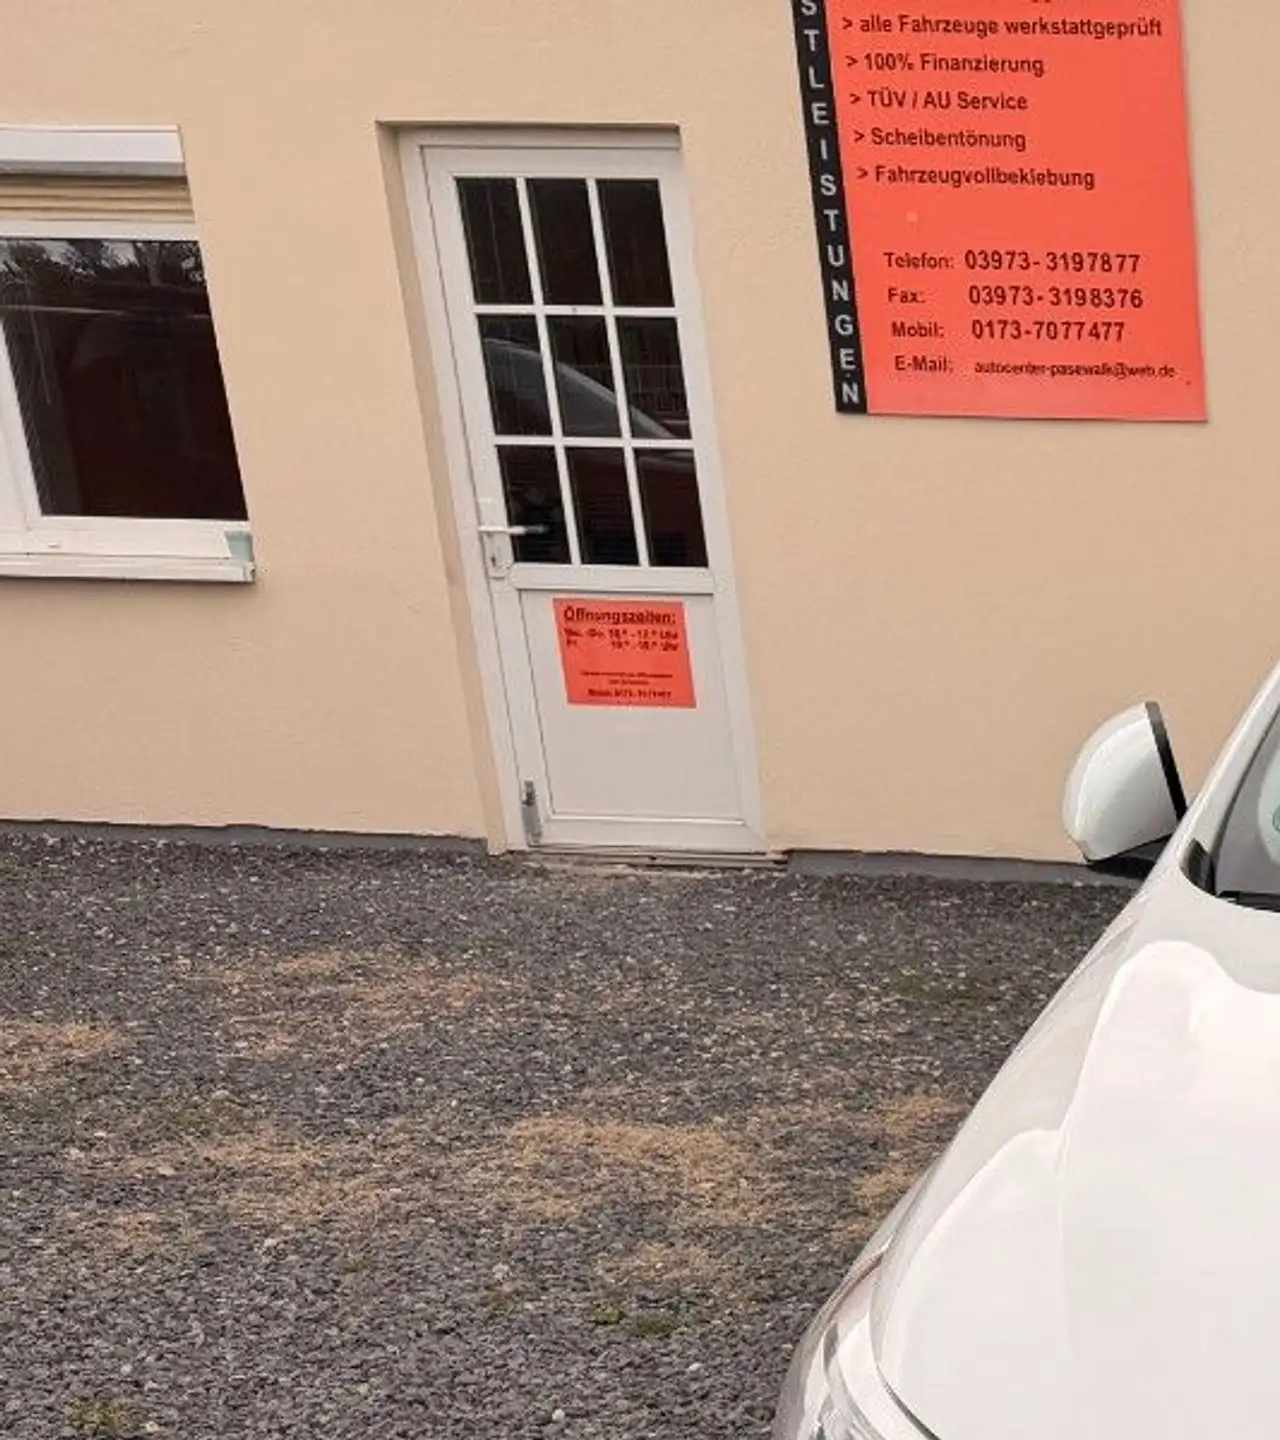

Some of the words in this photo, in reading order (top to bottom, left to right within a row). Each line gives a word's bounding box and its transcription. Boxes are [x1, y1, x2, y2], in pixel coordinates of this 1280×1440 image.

[859, 16, 892, 34] alle
[899, 15, 999, 37] Fahrzeuge
[1004, 16, 1162, 39] werkstattgeprüft
[864, 52, 914, 71] 100%
[920, 53, 1045, 77] Finanzierung
[867, 87, 908, 109] TÜV
[923, 91, 951, 109] AU
[957, 91, 1028, 110] Service
[871, 127, 1026, 151] Scheibentönung
[875, 165, 1095, 190] Fahrzeugvollbeklebung
[883, 252, 954, 270] Telefon:
[888, 288, 926, 304] Fax:
[892, 321, 945, 339] Mobil:
[972, 319, 1125, 341] 0173-7077477
[895, 354, 954, 374] E-Mail:
